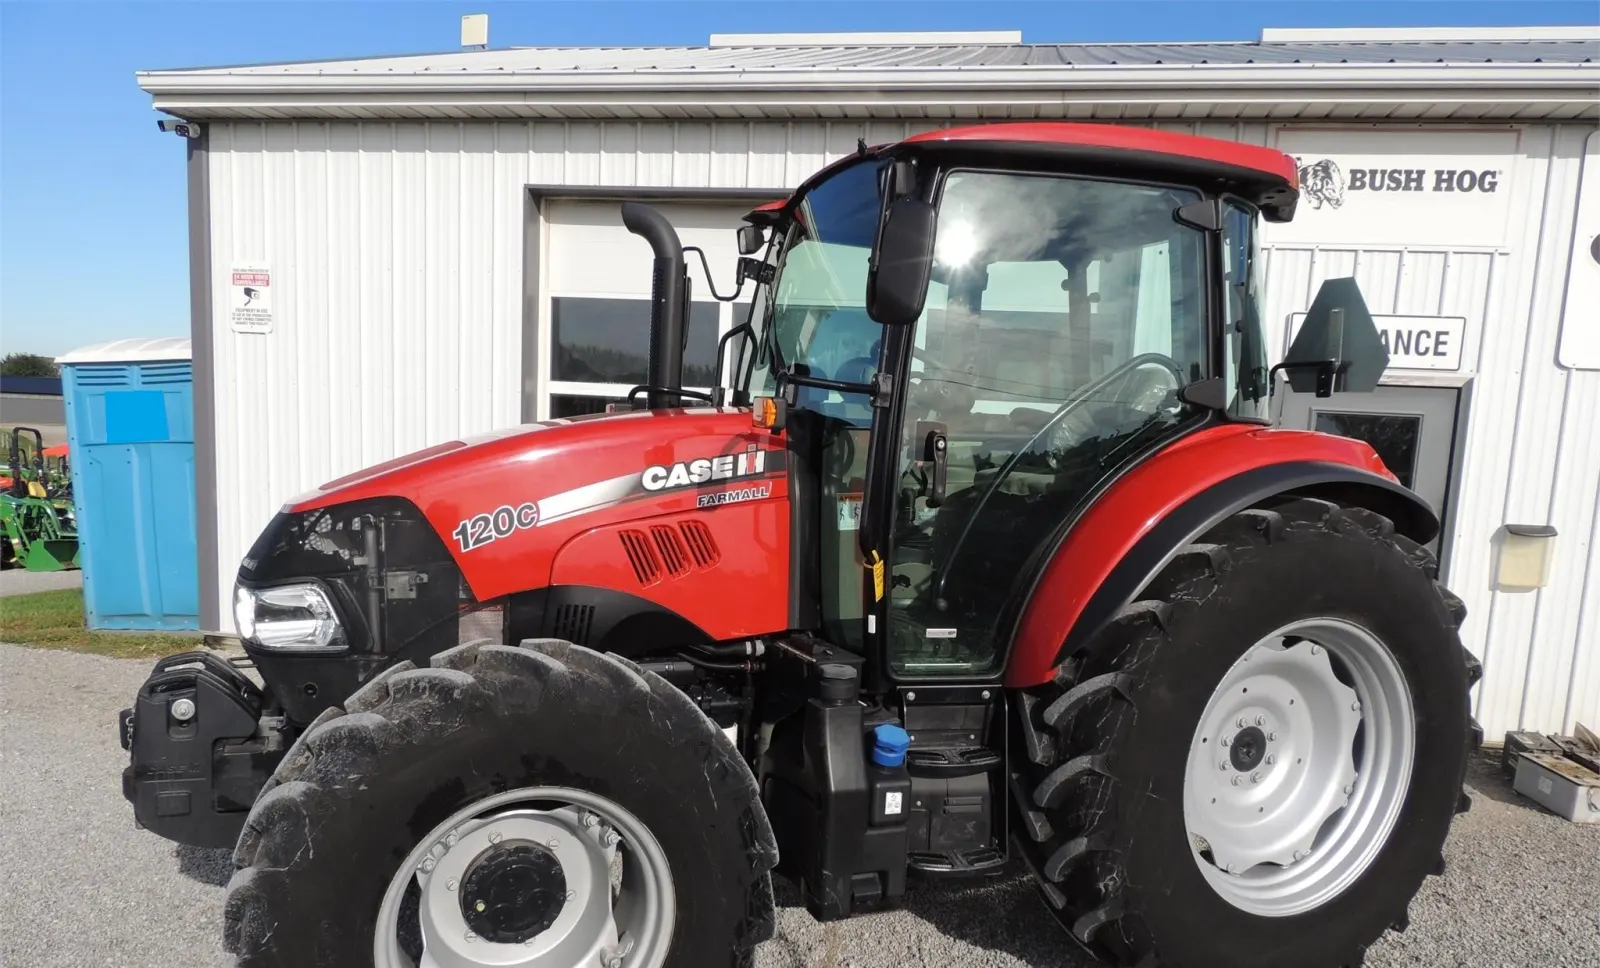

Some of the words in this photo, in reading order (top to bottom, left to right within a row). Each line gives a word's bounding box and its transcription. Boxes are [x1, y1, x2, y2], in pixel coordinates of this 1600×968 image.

[1347, 168, 1426, 192] BUSH
[1432, 169, 1499, 193] HOG
[1379, 329, 1450, 357] ANCE
[641, 455, 734, 491] CASE
[697, 486, 770, 508] FARMALL
